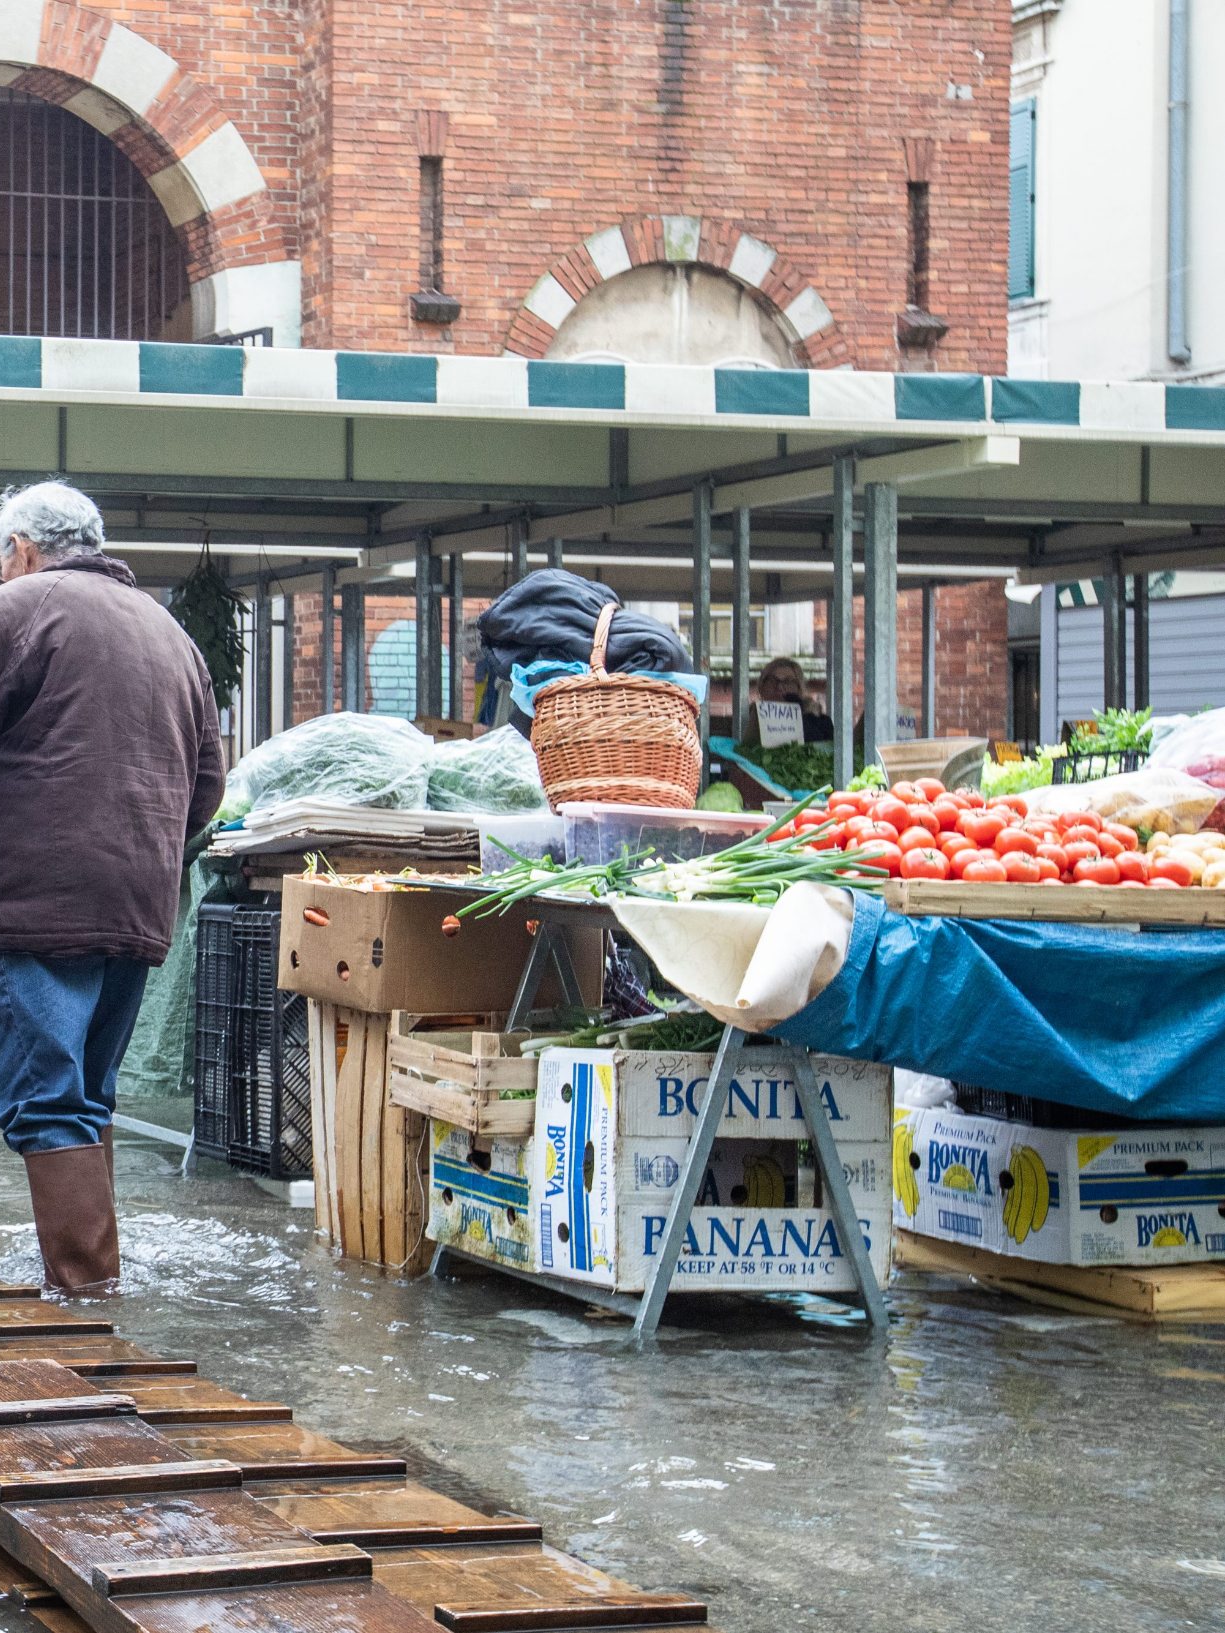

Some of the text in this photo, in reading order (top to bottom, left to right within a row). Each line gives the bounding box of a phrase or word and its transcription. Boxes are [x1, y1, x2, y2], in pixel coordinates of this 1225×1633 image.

[976, 1130, 997, 1144] PACK
[1113, 1141, 1170, 1155] PREMIUM
[1175, 1140, 1205, 1152] PACK
[545, 1123, 567, 1199] BONITA
[600, 1107, 608, 1217] PREMIUM PACK
[928, 1140, 993, 1195] BONITA
[461, 1202, 493, 1243] BONITA
[1136, 1212, 1201, 1248] BONITA
[677, 1261, 715, 1274] KEEP
[719, 1261, 737, 1274] AT
[740, 1261, 756, 1274] 58
[778, 1262, 797, 1274] OR
[801, 1261, 815, 1275] 14
